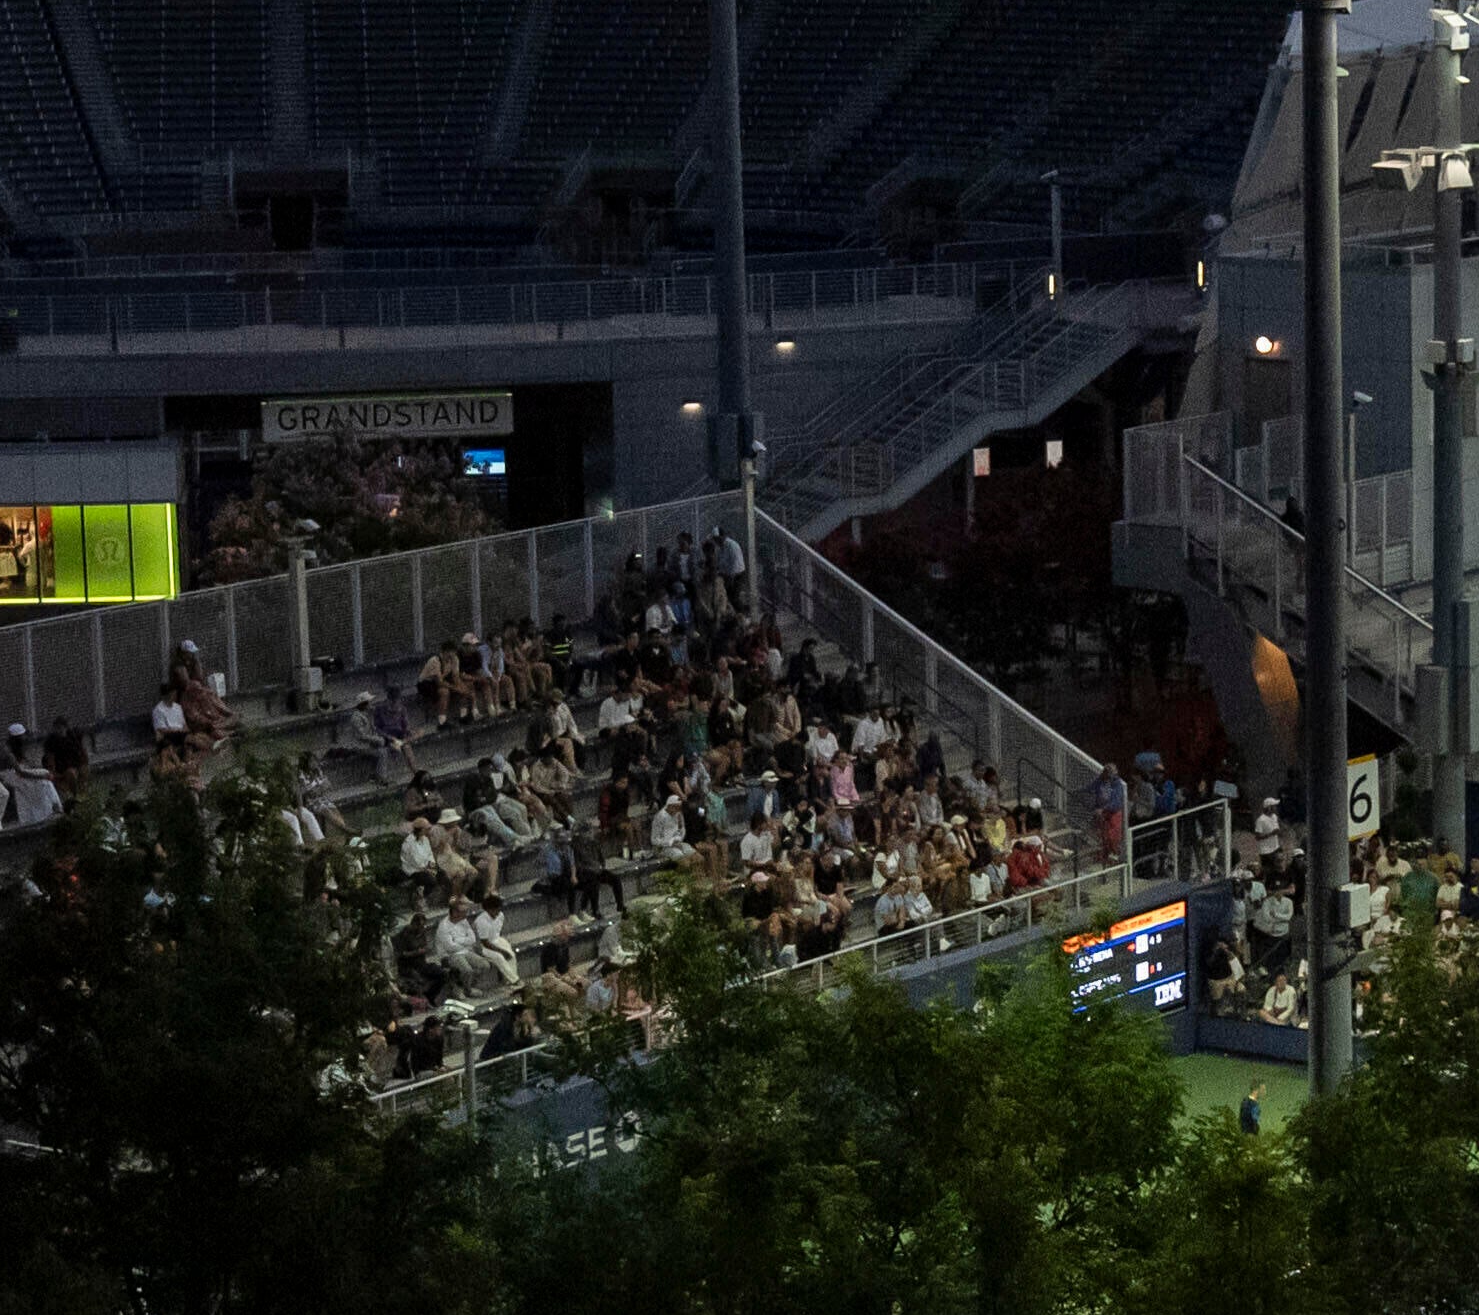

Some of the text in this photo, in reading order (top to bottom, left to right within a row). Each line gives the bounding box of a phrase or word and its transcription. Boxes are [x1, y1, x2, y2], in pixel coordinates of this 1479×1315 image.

[277, 399, 499, 431] GRANDSTAND
[1349, 773, 1373, 824] 6
[1154, 979, 1183, 1006] IBM
